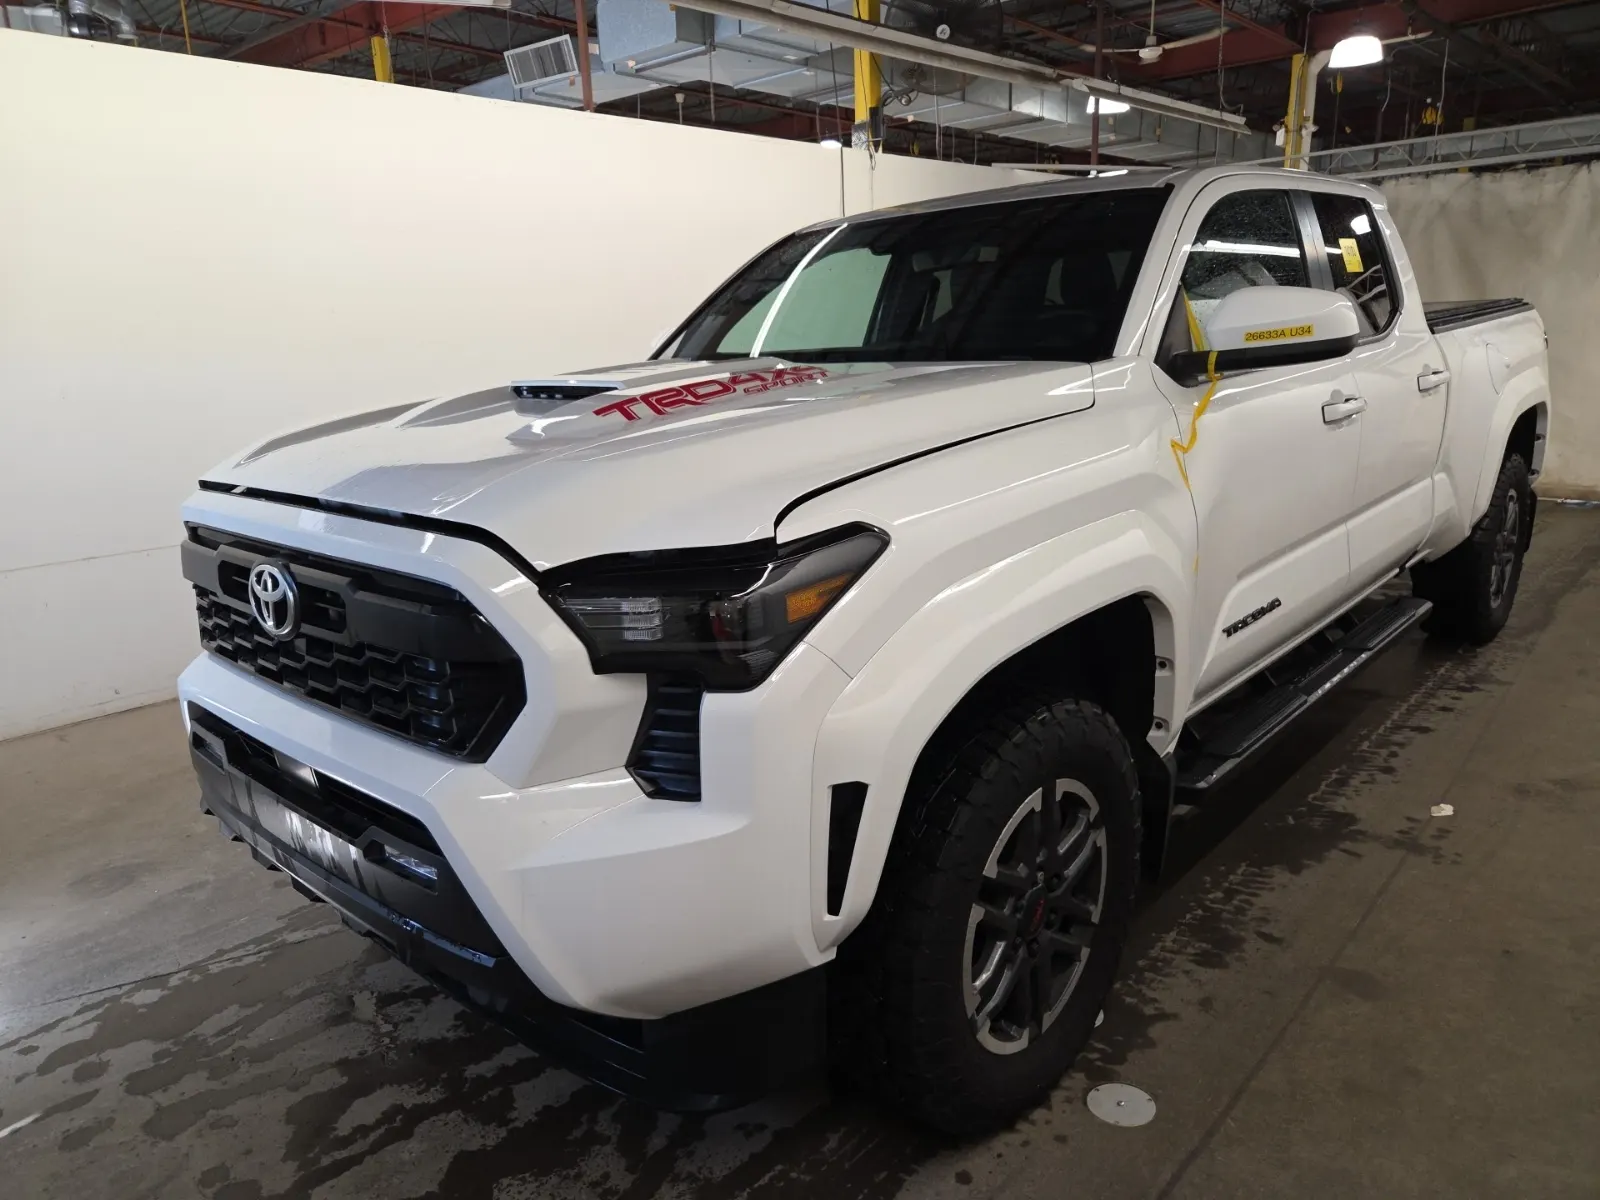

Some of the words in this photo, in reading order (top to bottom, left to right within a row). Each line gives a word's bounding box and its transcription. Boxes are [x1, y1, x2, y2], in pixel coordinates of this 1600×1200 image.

[1245, 329, 1286, 341] 26633A
[1290, 325, 1312, 337] U34
[743, 371, 829, 394] SPORT
[592, 379, 738, 422] TRD
